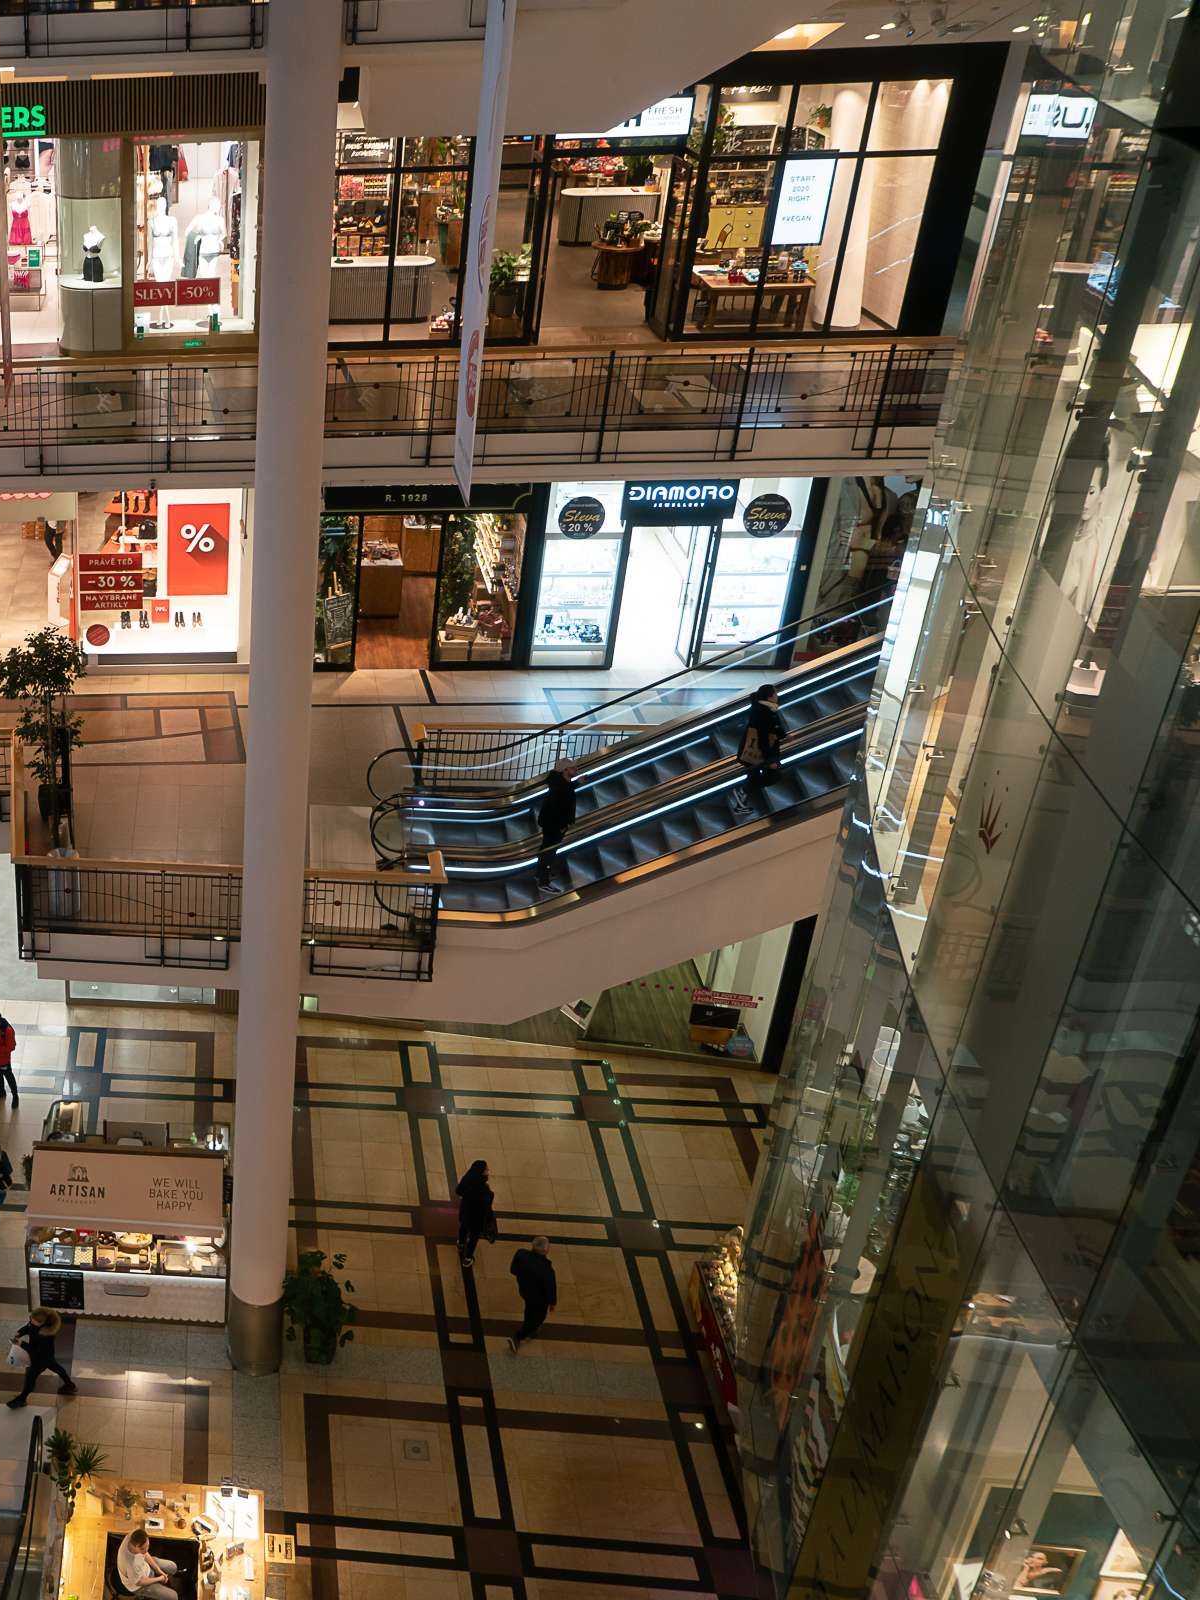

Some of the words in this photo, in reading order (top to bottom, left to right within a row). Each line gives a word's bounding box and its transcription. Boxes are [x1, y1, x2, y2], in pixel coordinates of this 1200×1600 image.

[789, 175, 816, 183] START
[135, 287, 174, 301] SLEVY
[182, 286, 214, 299] -50%
[400, 493, 429, 502] 1928
[628, 485, 734, 501] DIAMORO
[563, 509, 601, 522] Sleva
[747, 507, 786, 520] Sleva
[568, 523, 580, 532] 20
[752, 521, 765, 530] 20
[88, 557, 116, 566] PRÁVĚ
[94, 601, 129, 609] ARTIKLY
[152, 1177, 170, 1188] WE
[174, 1178, 201, 1190] WILL
[50, 1183, 105, 1199] ARTISAN
[148, 1189, 177, 1200] BAKE
[181, 1189, 204, 1201] YOU
